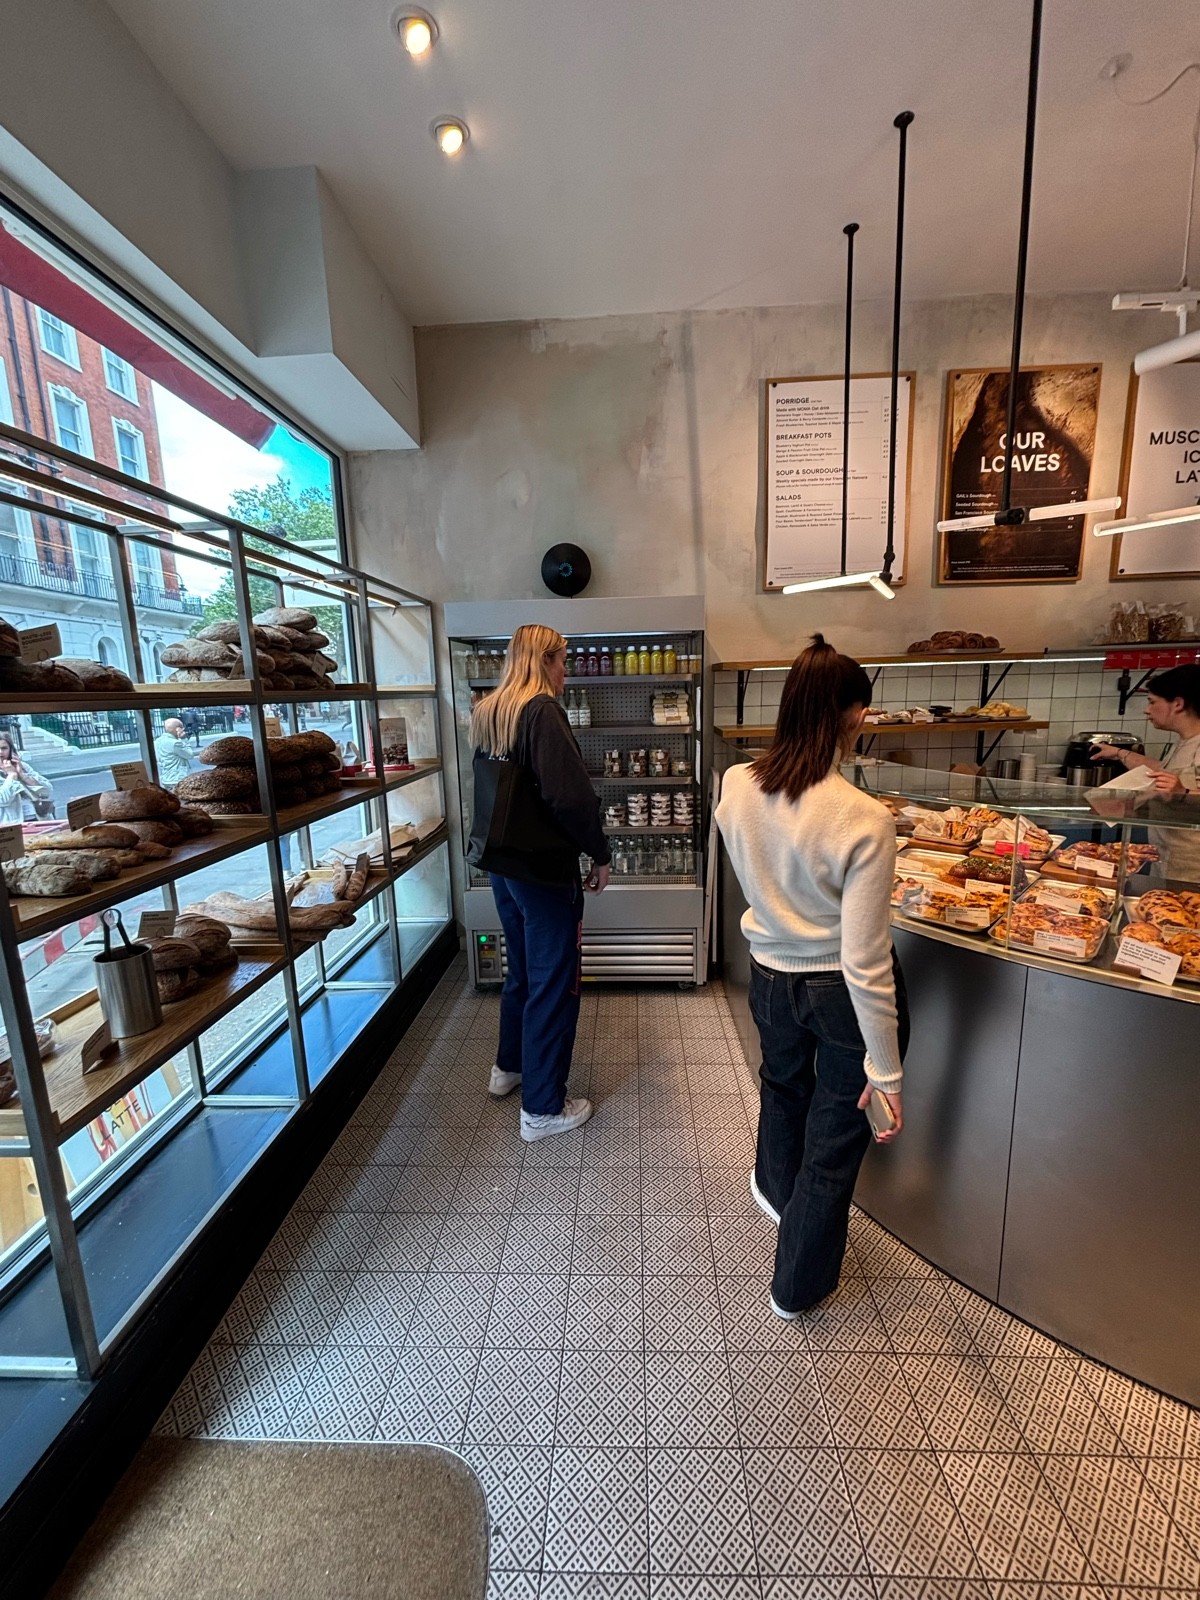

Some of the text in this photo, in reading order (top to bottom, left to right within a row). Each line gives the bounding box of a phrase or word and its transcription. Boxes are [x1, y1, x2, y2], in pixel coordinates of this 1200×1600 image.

[776, 397, 810, 405] PORRIDGE
[999, 432, 1045, 449] OUR
[1149, 430, 1200, 445] MUSC
[980, 453, 1060, 473] LOAVES
[101, 1099, 141, 1140] LATTE
